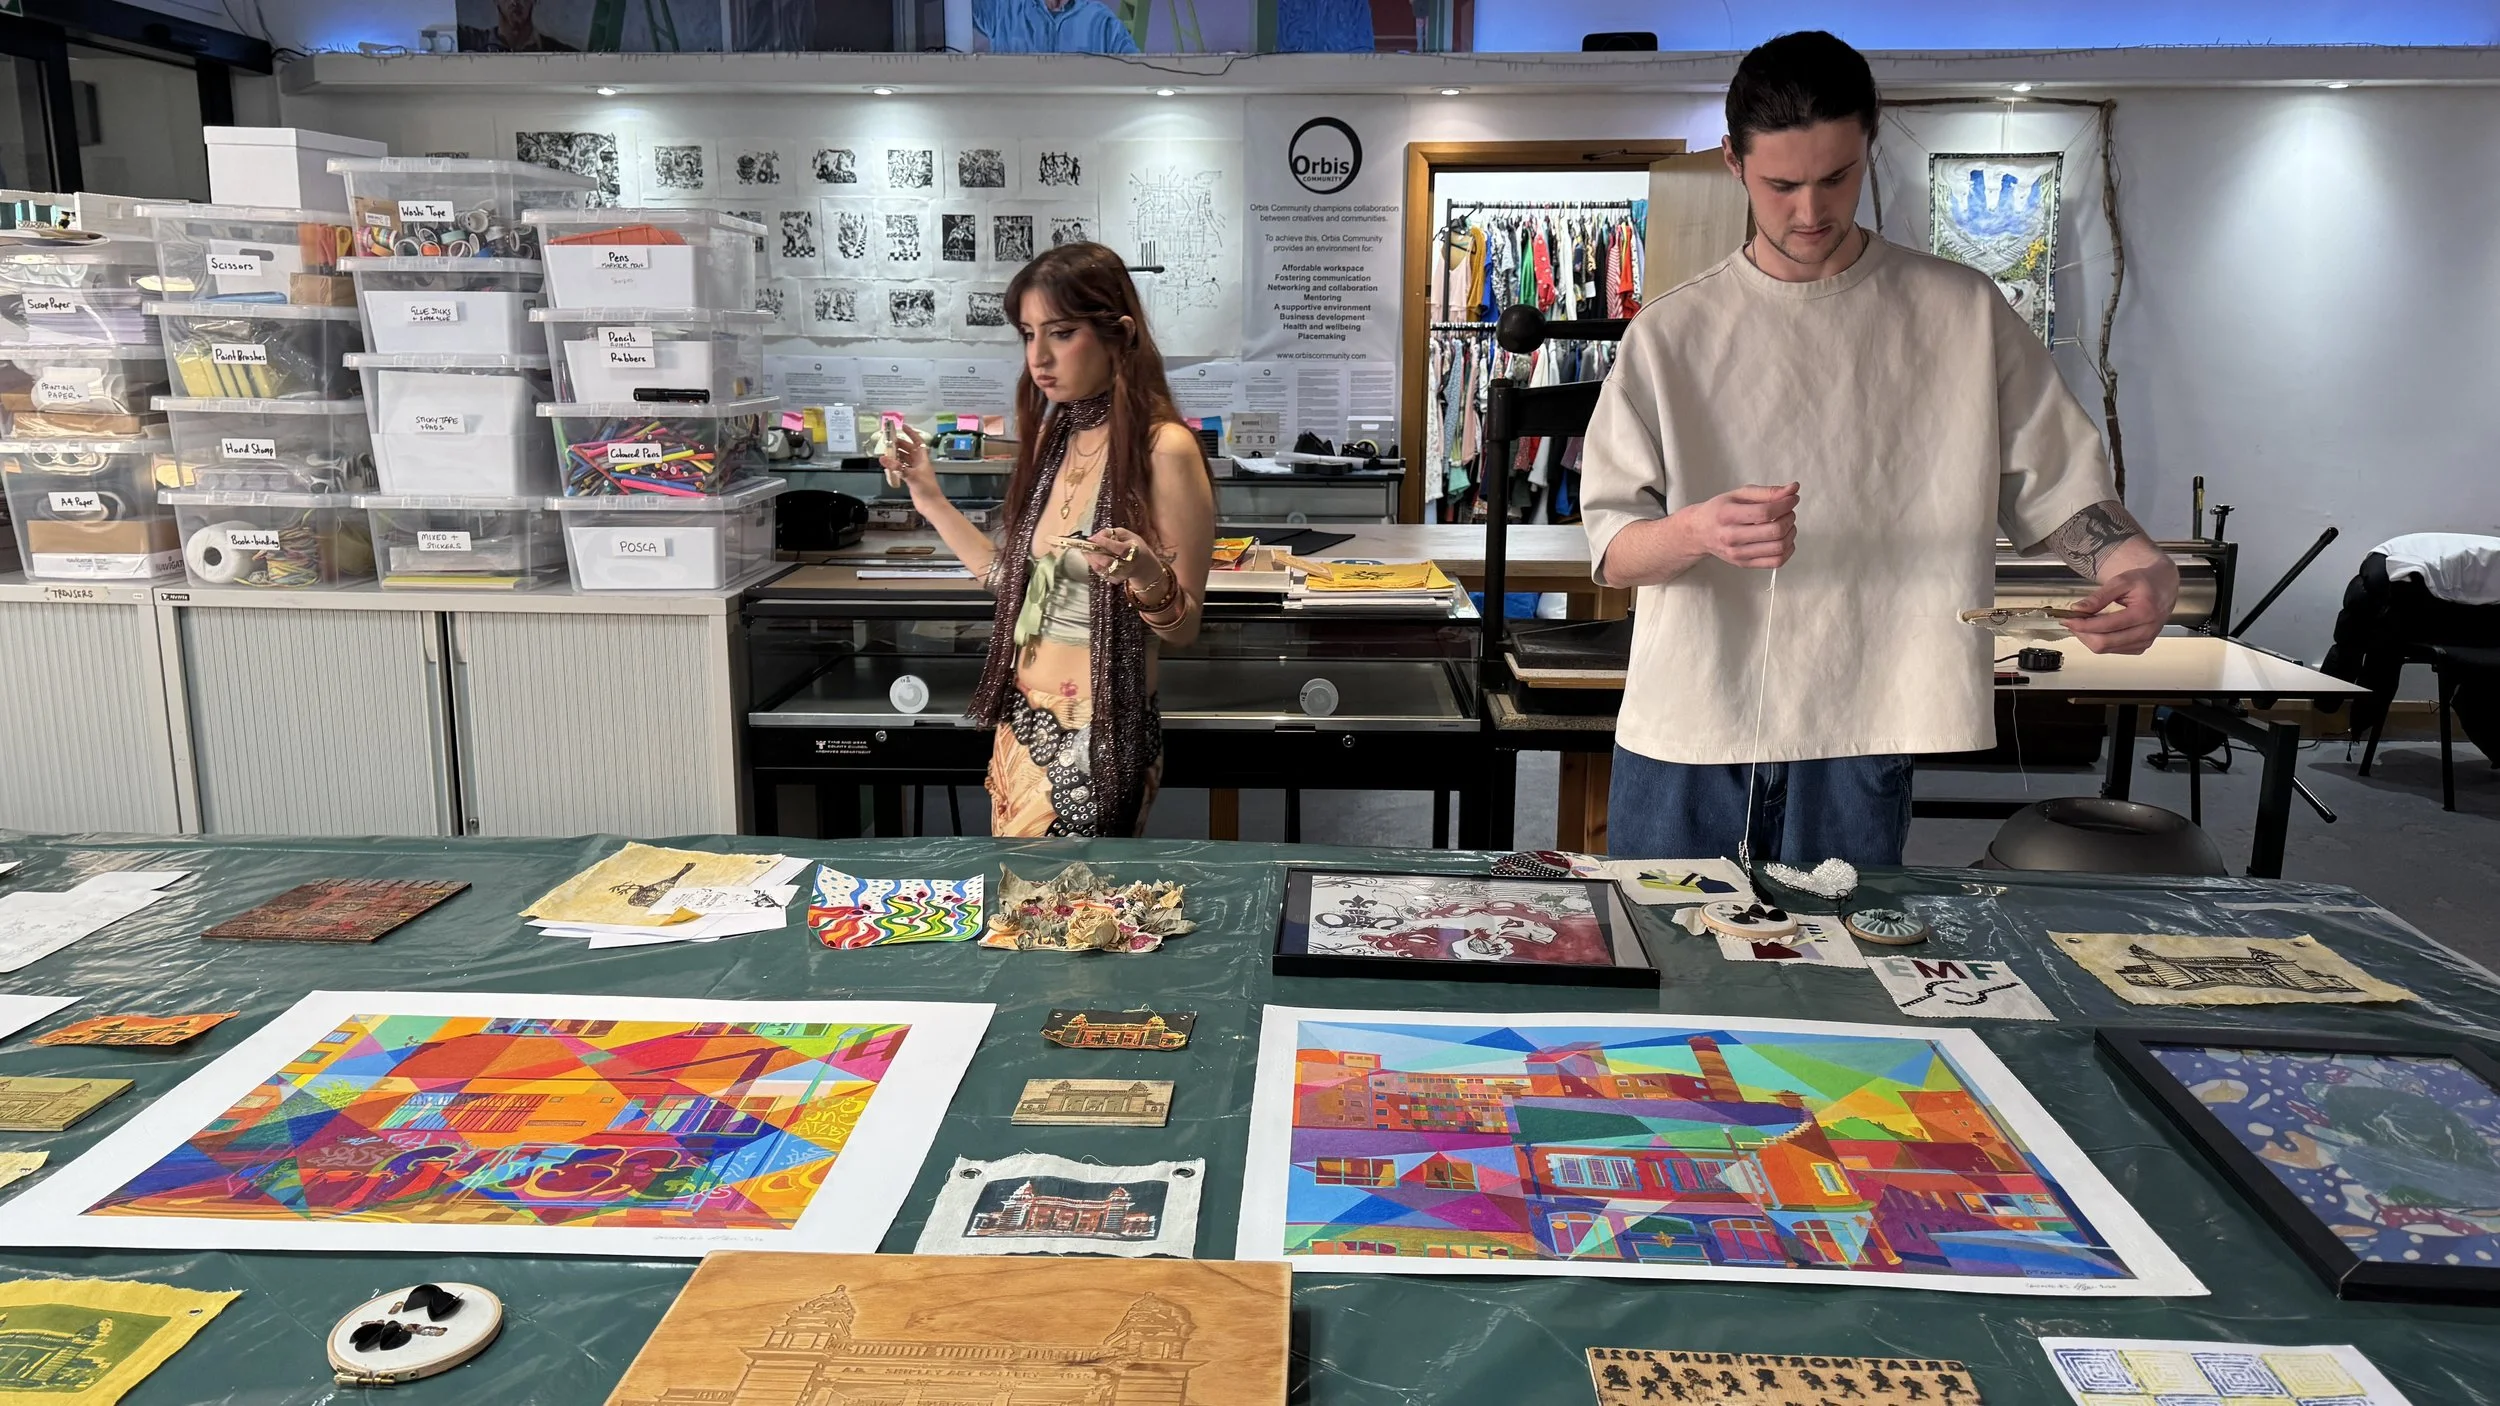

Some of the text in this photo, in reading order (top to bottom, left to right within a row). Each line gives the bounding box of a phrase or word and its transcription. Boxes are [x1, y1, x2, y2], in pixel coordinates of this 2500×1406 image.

[1292, 155, 1350, 175] Orbis
[401, 205, 446, 218] Washi Tape
[1270, 204, 1312, 213] Community
[1313, 204, 1352, 213] champions
[1265, 234, 1274, 242] To
[1275, 234, 1303, 242] achieve
[1321, 234, 1341, 242] Orbis
[1342, 234, 1383, 243] Community
[1273, 244, 1304, 253] provides
[608, 252, 630, 262] Pens
[211, 258, 254, 270] Scissors
[1323, 265, 1364, 273] workspace
[1274, 274, 1311, 282] Fostering
[1267, 284, 1308, 293] Networking
[1303, 294, 1342, 302] Mentoring
[28, 297, 70, 310] Scrap Paper
[1281, 304, 1322, 312] supportive
[1316, 313, 1365, 321] development
[1325, 323, 1361, 331] wellbeing
[608, 332, 636, 342] Pencils
[1297, 333, 1346, 341] Placemaking
[215, 349, 266, 362] Paint Brushes
[610, 352, 646, 363] Rubbers
[1276, 352, 1367, 360] www.orbiscommunity.com
[439, 416, 459, 425] TAPE
[225, 443, 274, 456] Hand Stamp
[642, 448, 660, 459] Pens
[61, 497, 94, 507] A4 Paper
[426, 542, 462, 550] STICKERS
[620, 542, 657, 553] POSCA
[52, 589, 94, 599] TROUSERS
[1880, 958, 2000, 981] EMF
